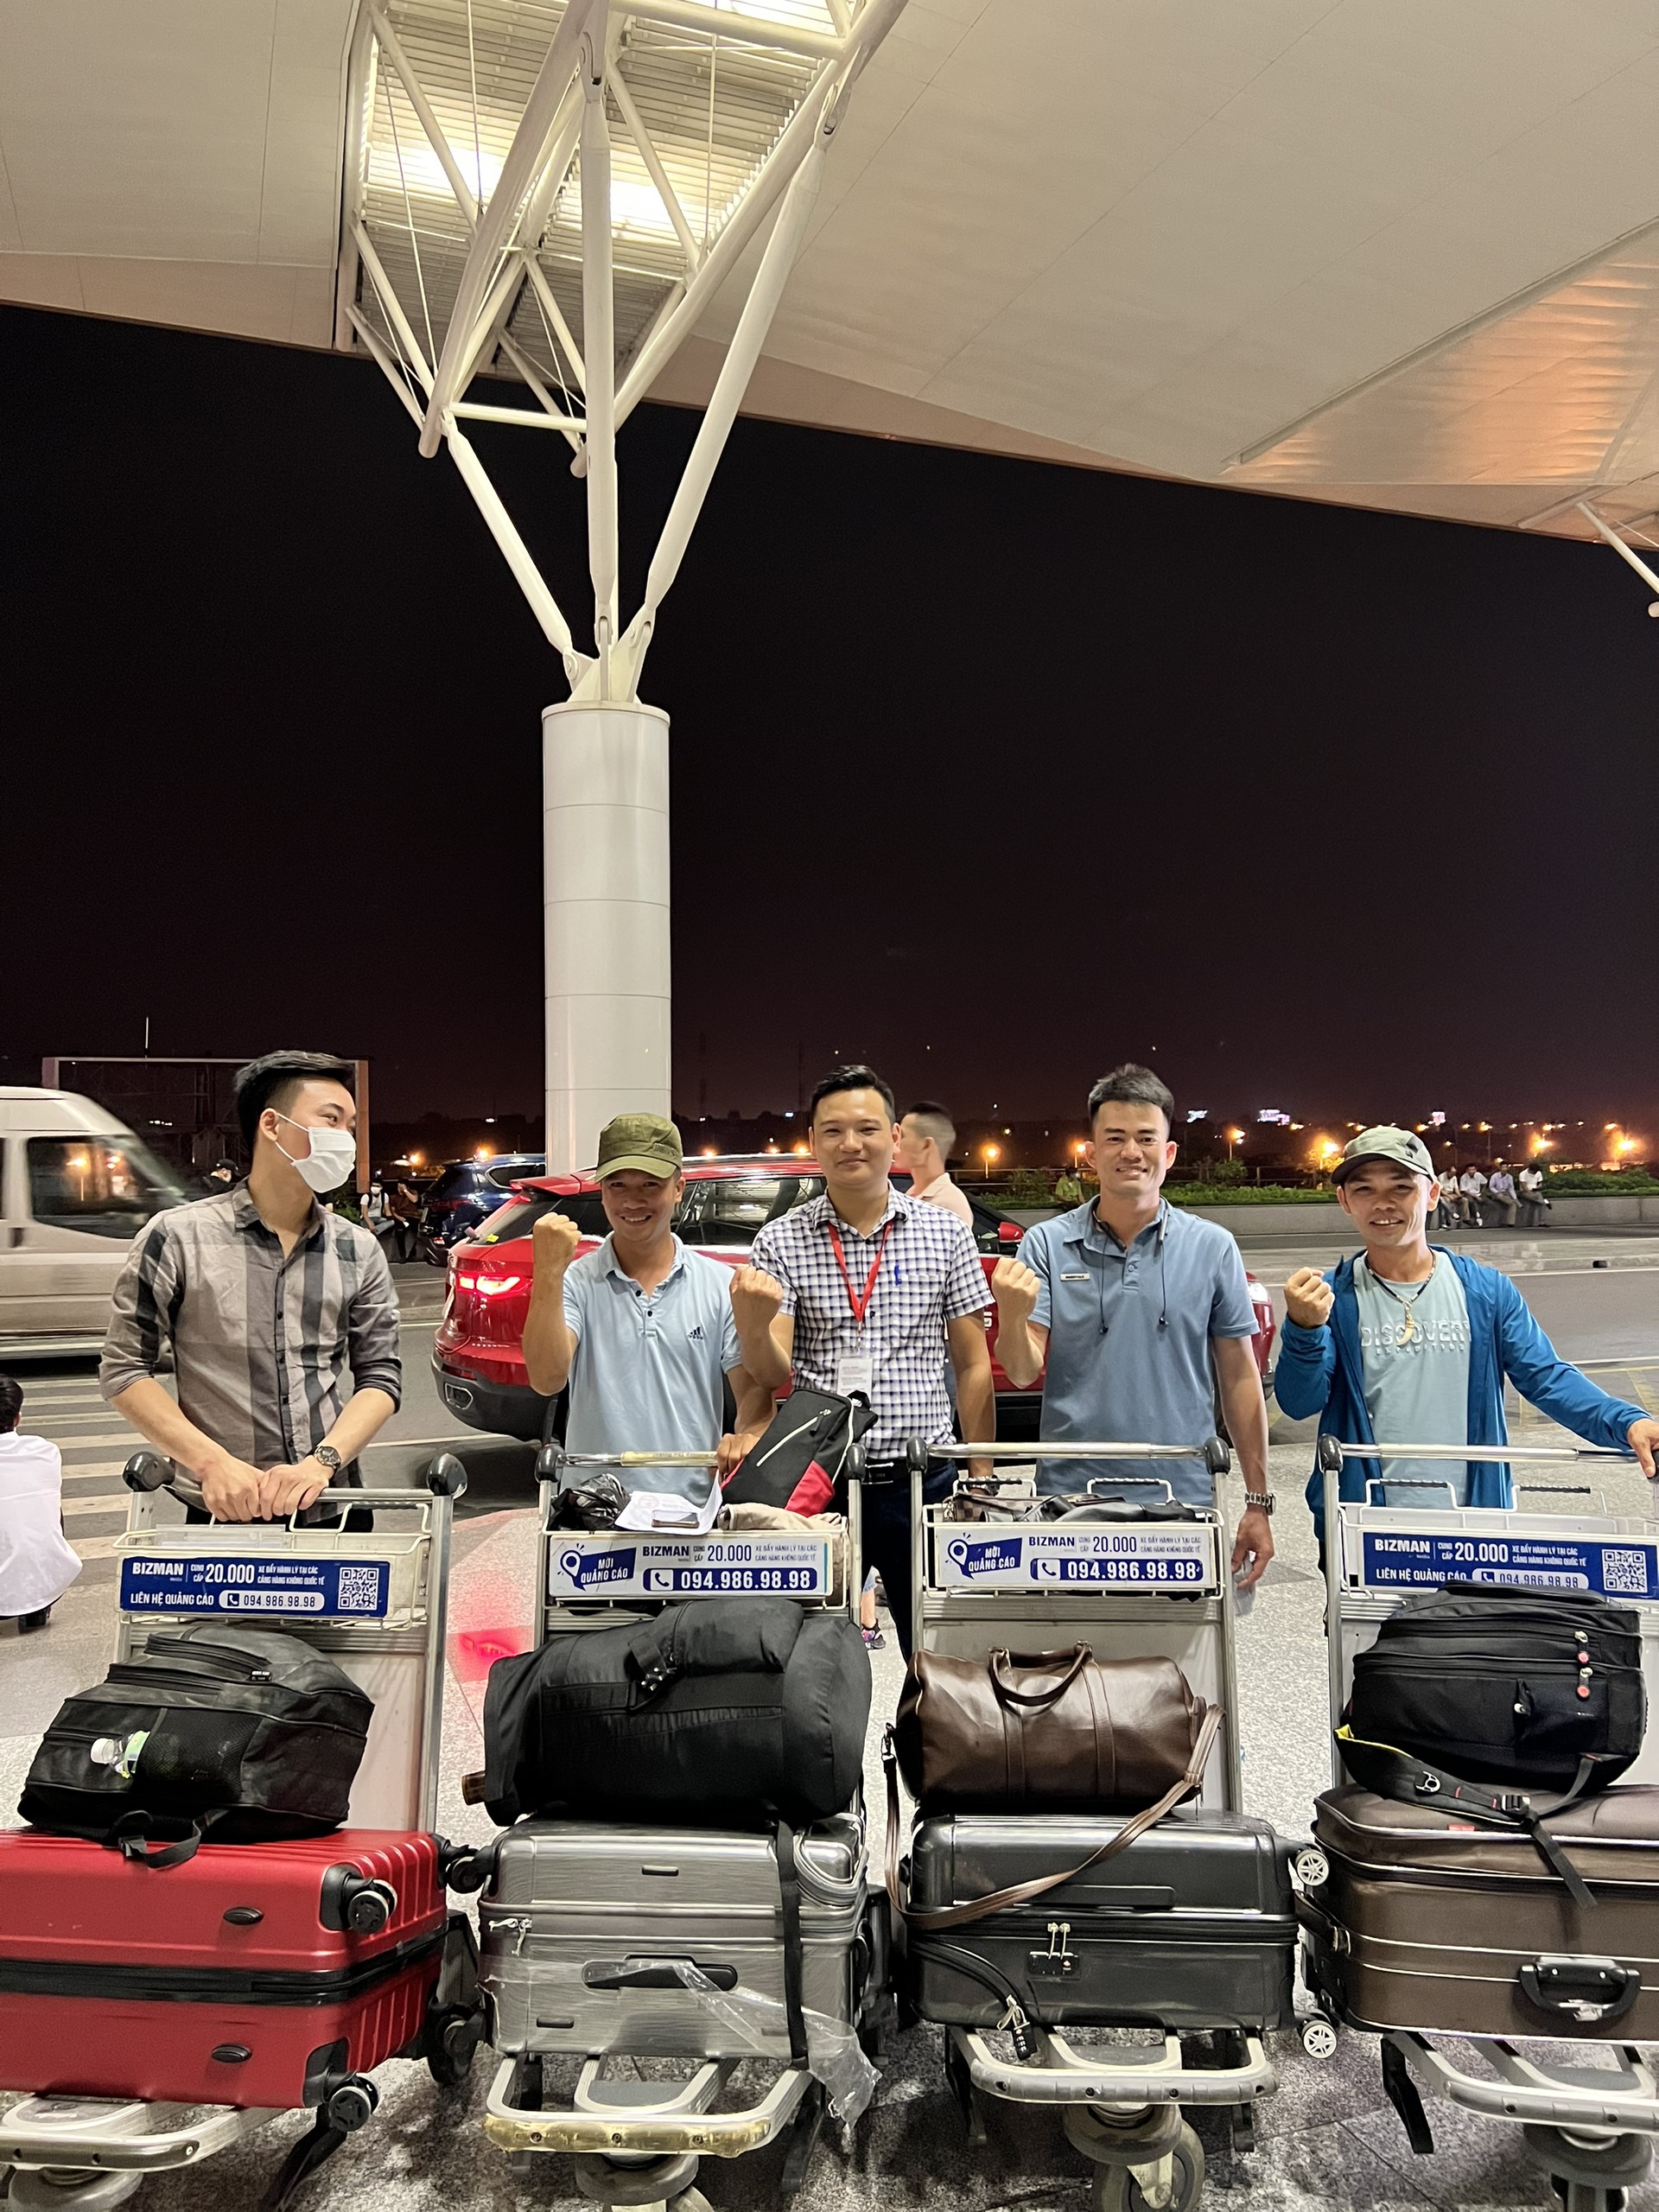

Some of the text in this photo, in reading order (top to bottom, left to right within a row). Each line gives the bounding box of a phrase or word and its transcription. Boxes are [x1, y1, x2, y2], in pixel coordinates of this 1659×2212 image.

[1028, 1536, 1075, 1547] BIZMAN
[1092, 1536, 1137, 1553] 20.000
[1375, 1539, 1430, 1553] BIZMAN
[642, 1545, 690, 1557] BIZMAN
[707, 1544, 752, 1562] 20.000
[1454, 1541, 1509, 1563] 20.000
[132, 1562, 184, 1575] BIZMAN
[998, 1555, 1015, 1568] CÁO
[206, 1563, 255, 1584] 20.000
[611, 1566, 628, 1580] CÁO
[1067, 1560, 1196, 1580] 094.986.98.98
[1376, 1567, 1397, 1580] LIÊN
[1399, 1567, 1411, 1582] HỆ
[1413, 1567, 1446, 1581] QUẢNG
[681, 1570, 810, 1589] 094.986.98.98
[130, 1591, 214, 1606] LIÊN HỆ QUẢNG CÁO
[244, 1594, 316, 1608] 094.986.98.98
